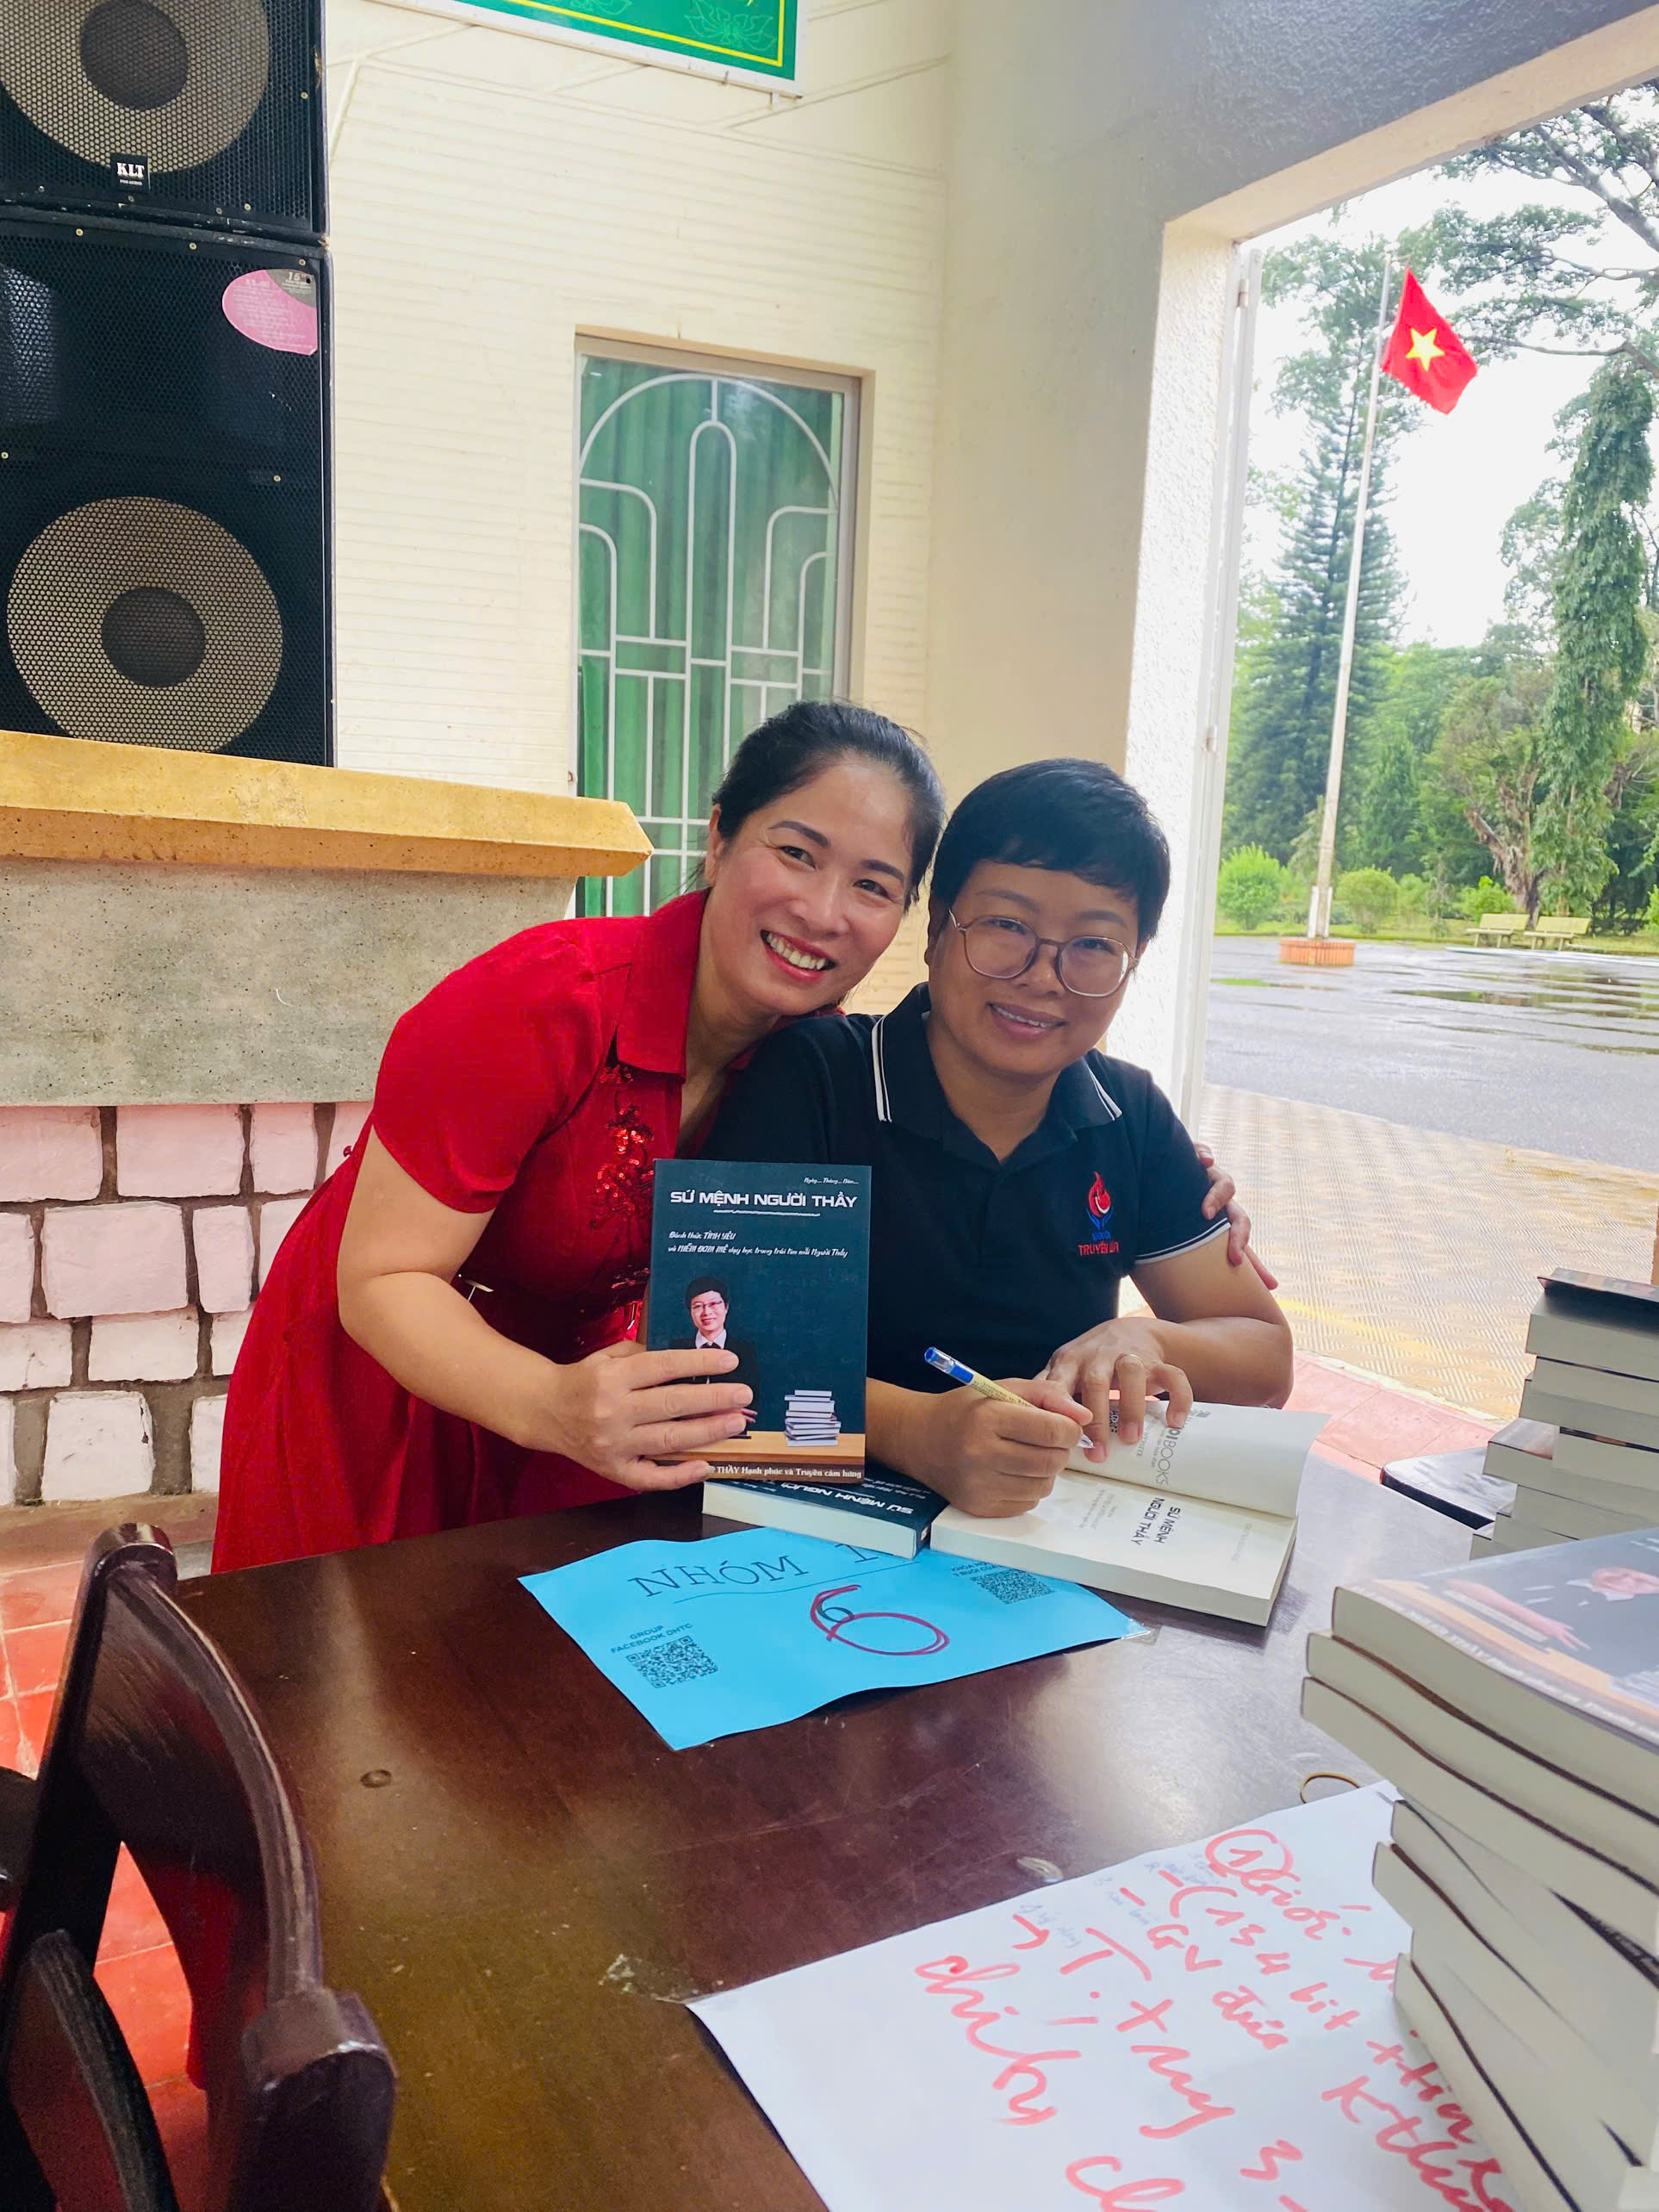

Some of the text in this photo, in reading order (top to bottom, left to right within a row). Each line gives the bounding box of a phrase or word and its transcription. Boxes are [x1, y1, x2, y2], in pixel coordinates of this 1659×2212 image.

[116, 162, 145, 178] KLT
[670, 1189, 858, 1208] SỨ MỆNH NGƯỜI THẦY
[717, 1464, 739, 1474] THẦY
[741, 1466, 762, 1476] Hạnh
[764, 1467, 783, 1476] phúc
[795, 1468, 823, 1478] Truyền
[627, 1556, 809, 1598] NHÓM
[629, 1625, 664, 1641] GROUP
[610, 1632, 666, 1654] FACEBOOK
